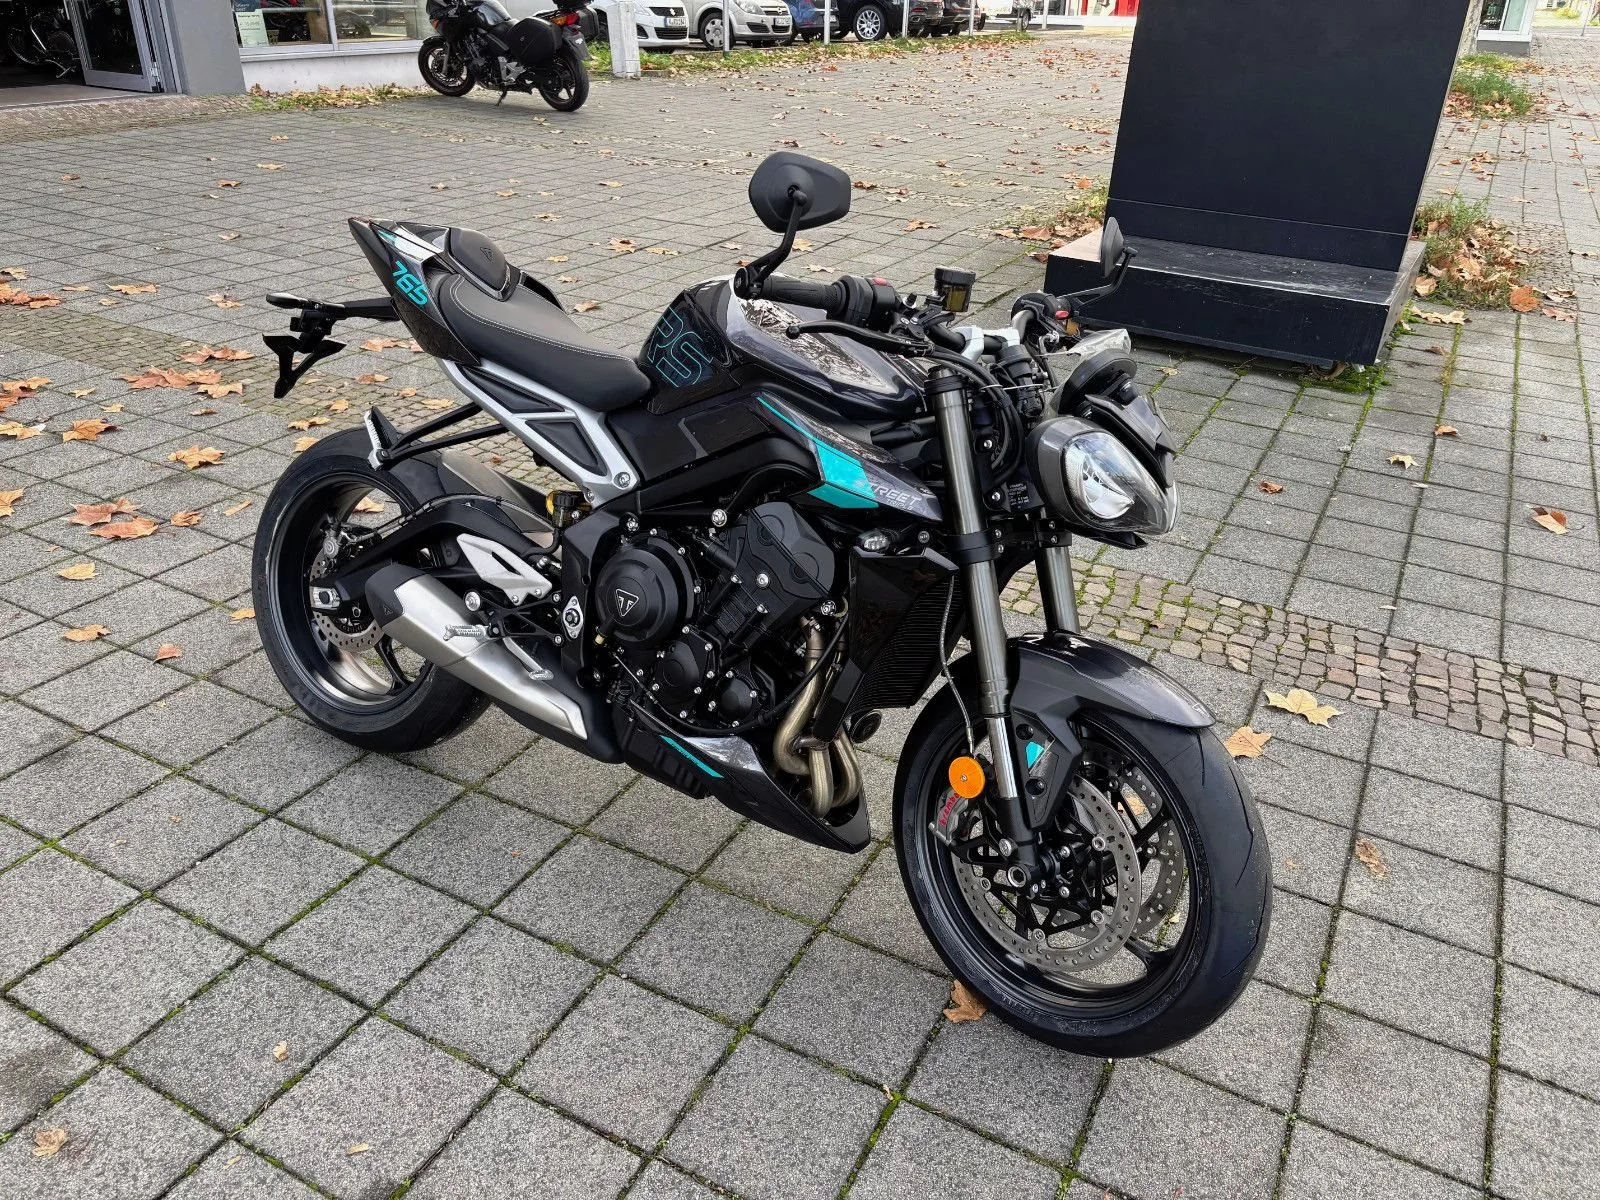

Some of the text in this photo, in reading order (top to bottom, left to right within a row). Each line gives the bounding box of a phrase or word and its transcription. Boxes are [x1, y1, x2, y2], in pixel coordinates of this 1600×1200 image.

[391, 260, 428, 306] 765
[647, 306, 714, 388] RS
[938, 792, 960, 826] brembo
